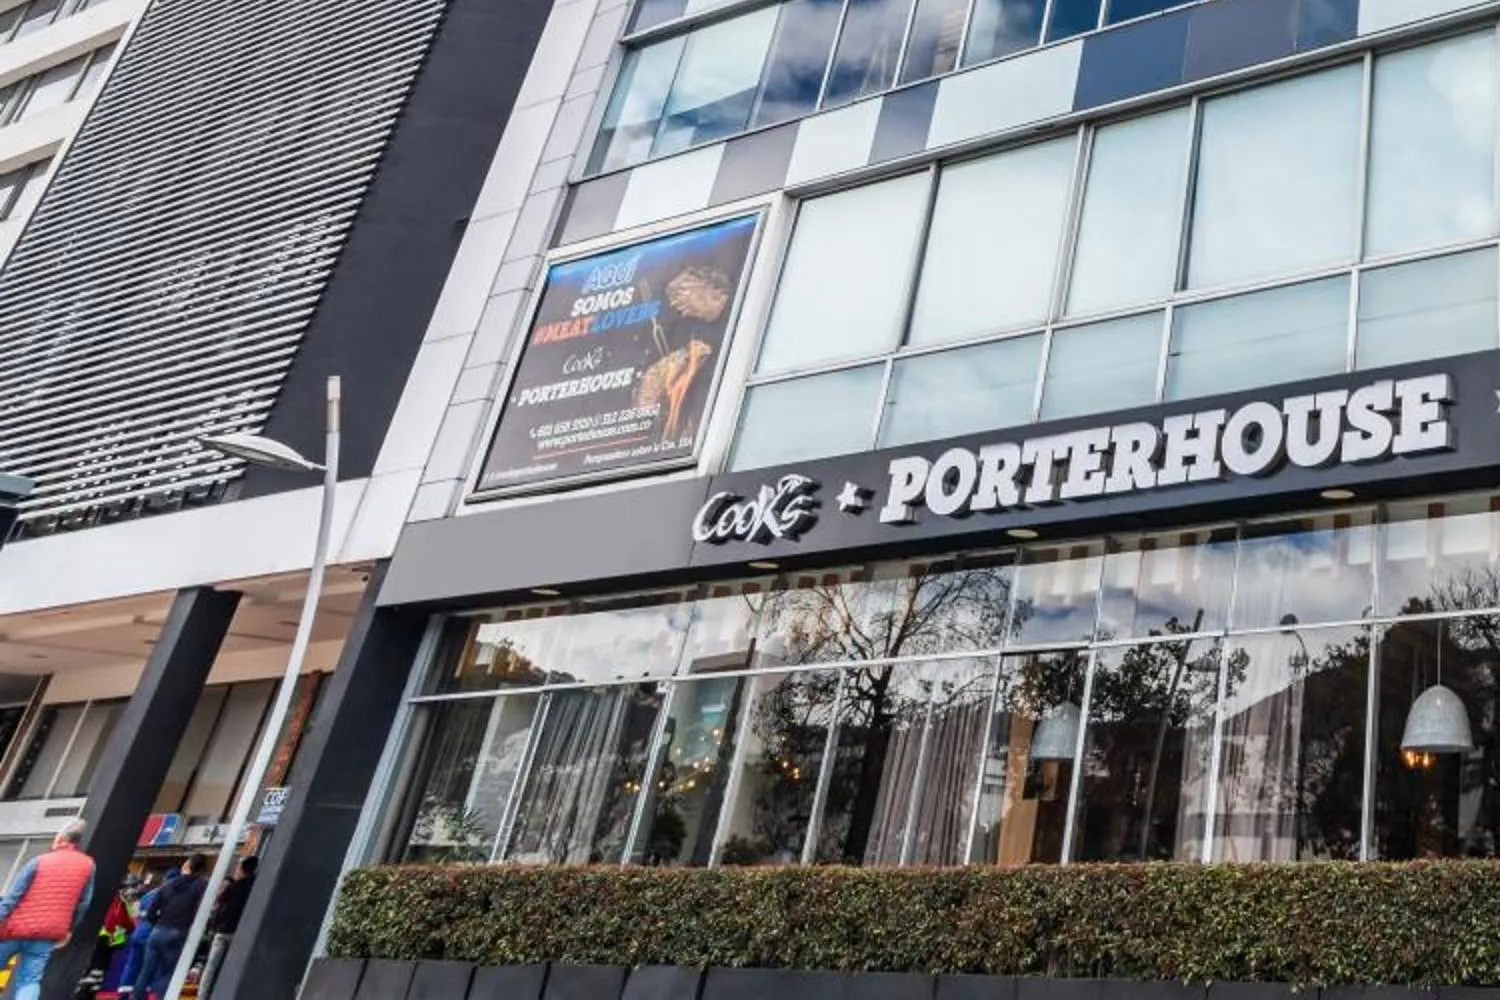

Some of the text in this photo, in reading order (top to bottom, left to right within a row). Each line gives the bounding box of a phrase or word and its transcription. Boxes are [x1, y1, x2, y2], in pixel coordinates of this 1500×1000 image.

[570, 287, 635, 317] SOMOS
[518, 368, 635, 406] PORTERHOUSE
[879, 373, 1451, 523] PORTERHOUSE
